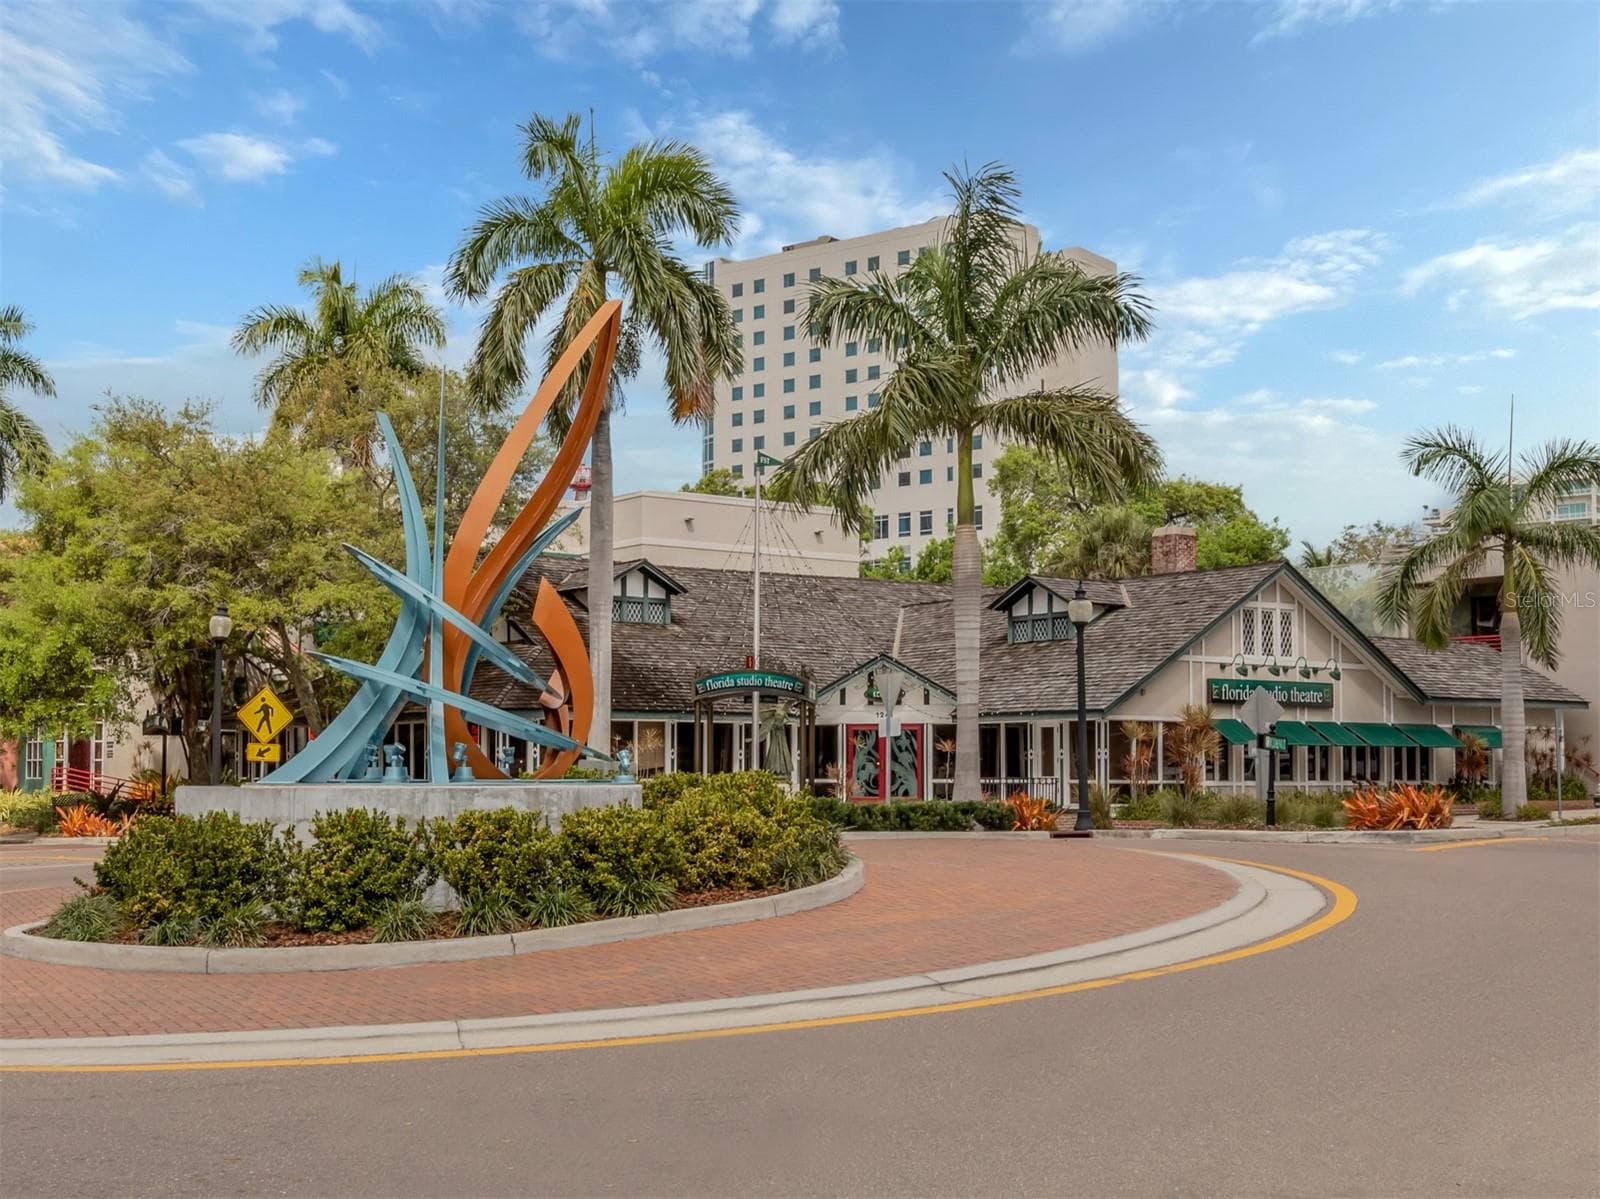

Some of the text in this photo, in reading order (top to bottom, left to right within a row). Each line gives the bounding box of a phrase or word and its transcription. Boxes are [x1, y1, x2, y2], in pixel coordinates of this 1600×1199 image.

[706, 676, 735, 691] florida
[737, 674, 763, 687] studio
[764, 675, 794, 691] theatre
[1290, 686, 1323, 703] theatre
